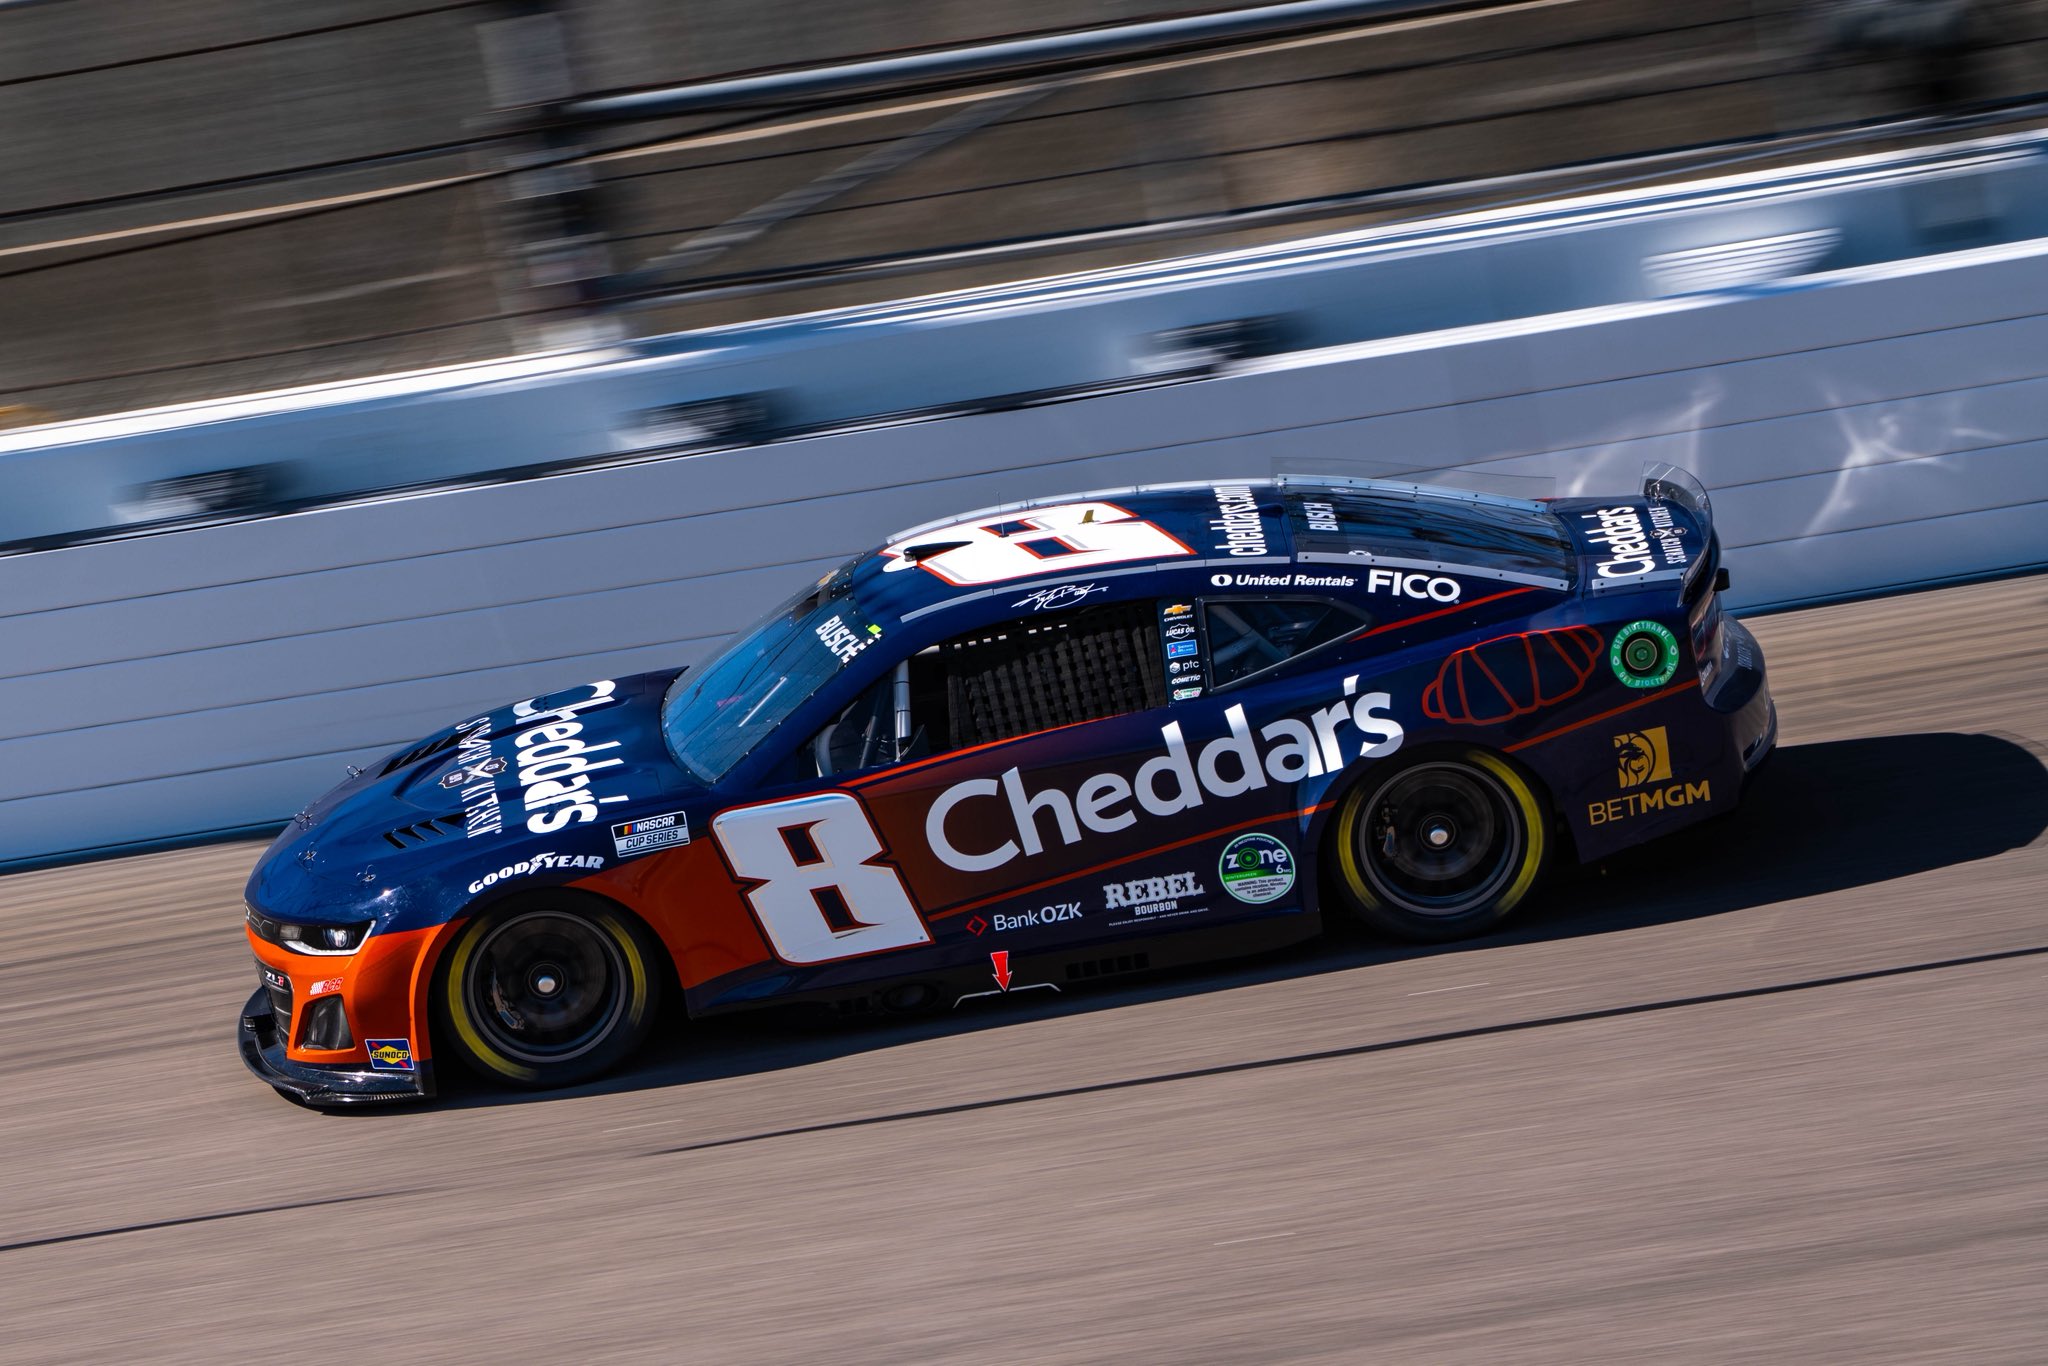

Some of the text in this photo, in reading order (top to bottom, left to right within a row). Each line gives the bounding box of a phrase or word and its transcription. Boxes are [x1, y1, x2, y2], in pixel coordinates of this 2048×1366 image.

[1303, 502, 1339, 531] BUSCH
[1581, 506, 1656, 578] Cheddar's
[1236, 574, 1355, 587] United Rentals
[1367, 568, 1461, 602] FICO
[815, 615, 866, 664] BUSCH
[1166, 625, 1195, 637] LUCAS OIL
[1183, 660, 1200, 671] ptc
[925, 675, 1404, 873] Cheddar's
[1588, 780, 1711, 826] BETMGM
[626, 830, 679, 849] CUP SERIES
[635, 815, 676, 834] NASCAR
[468, 851, 605, 894] GOODYEAR
[712, 790, 932, 967] 8
[1103, 871, 1206, 909] REBEL
[993, 901, 1083, 931] Bank OZK
[1134, 900, 1178, 916] BOURBON
[373, 1050, 409, 1060] SUNOCO
